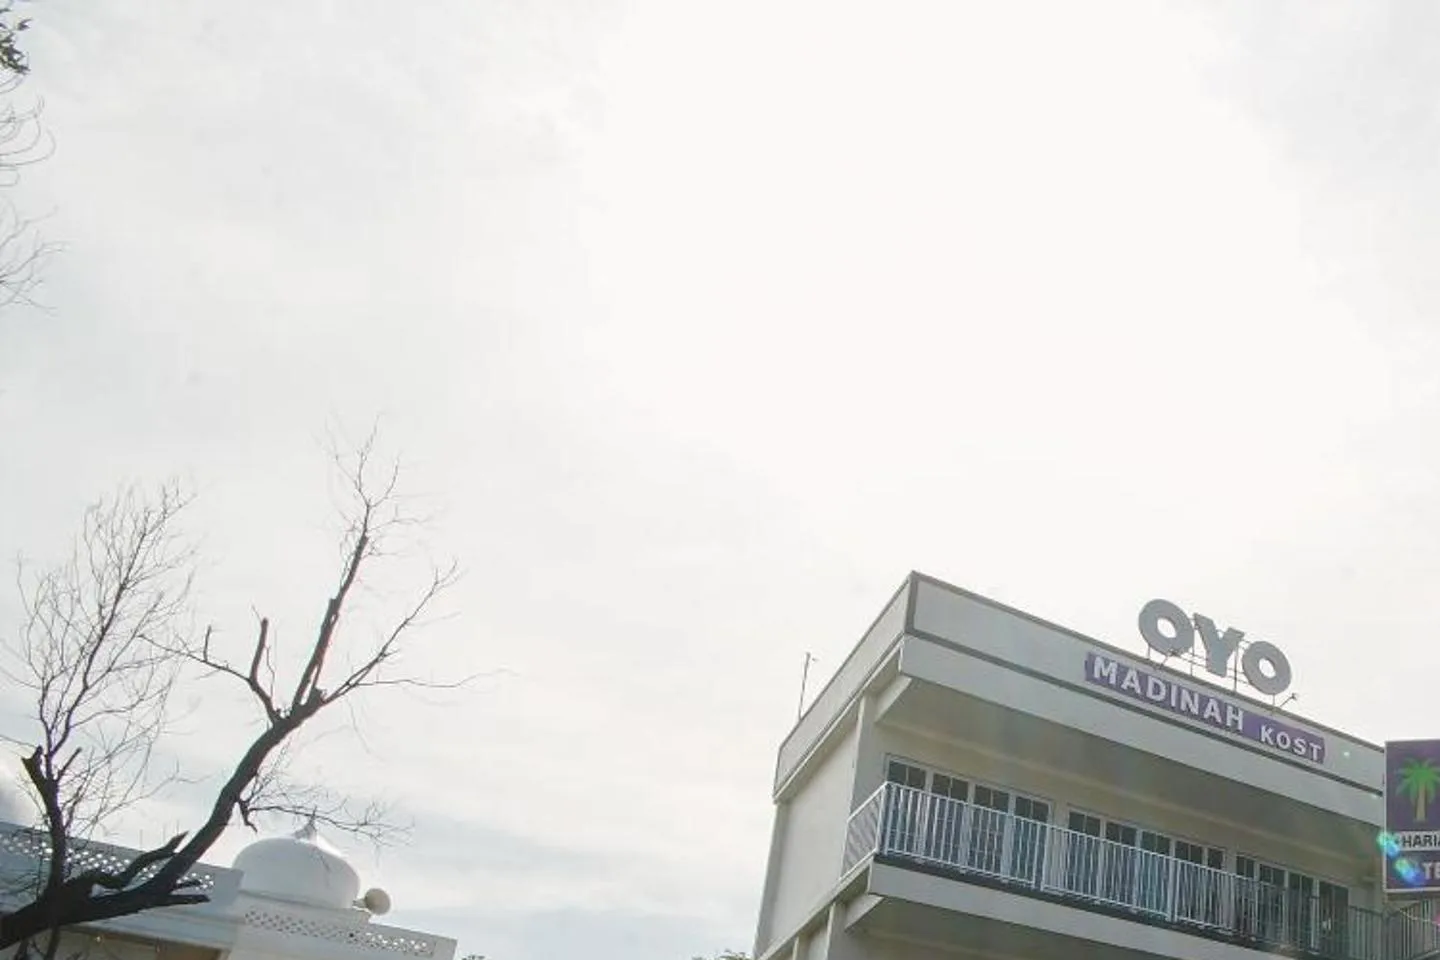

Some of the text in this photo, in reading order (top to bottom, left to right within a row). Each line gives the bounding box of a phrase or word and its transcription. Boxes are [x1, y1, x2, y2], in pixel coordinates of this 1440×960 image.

[1138, 598, 1292, 695] OYO
[1093, 655, 1322, 762] MADINAH KOST
